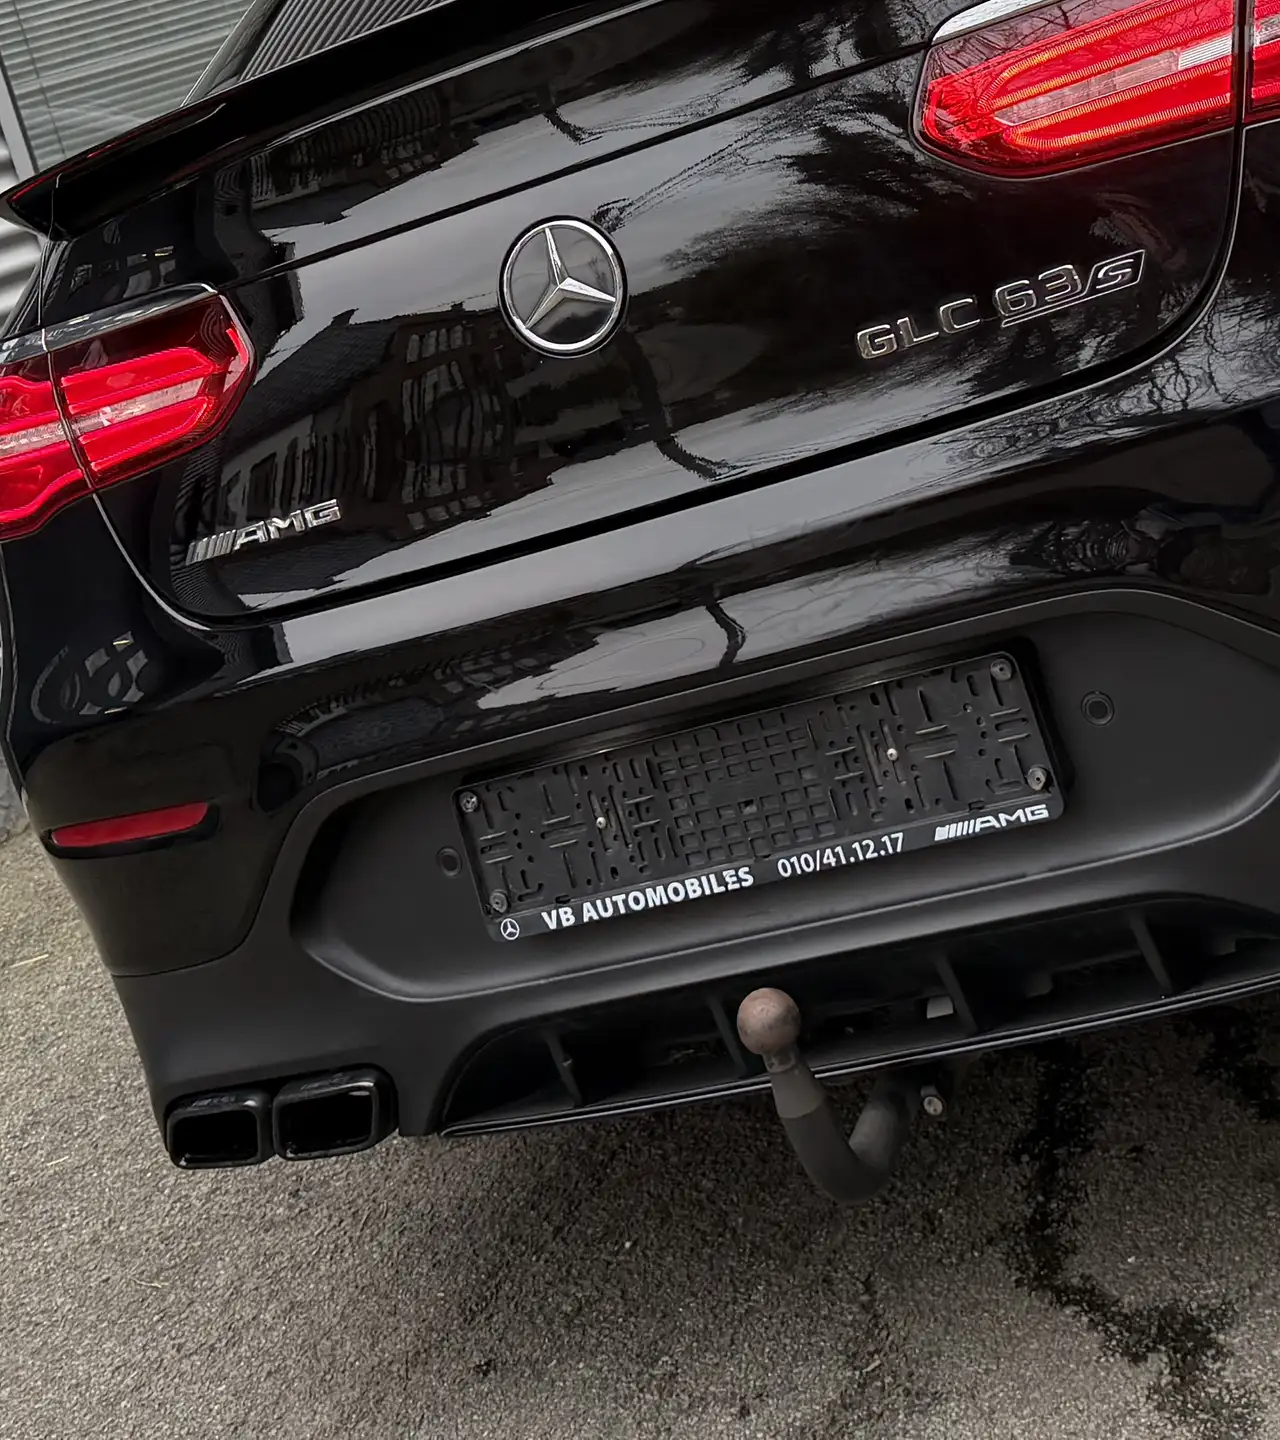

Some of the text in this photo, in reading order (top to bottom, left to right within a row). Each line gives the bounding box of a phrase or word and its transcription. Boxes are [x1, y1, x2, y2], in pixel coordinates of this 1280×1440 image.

[856, 297, 981, 359] GLC
[541, 907, 575, 931] VB
[582, 866, 755, 923] AUTOMOBILES
[777, 832, 905, 879] 010/41.12.17
